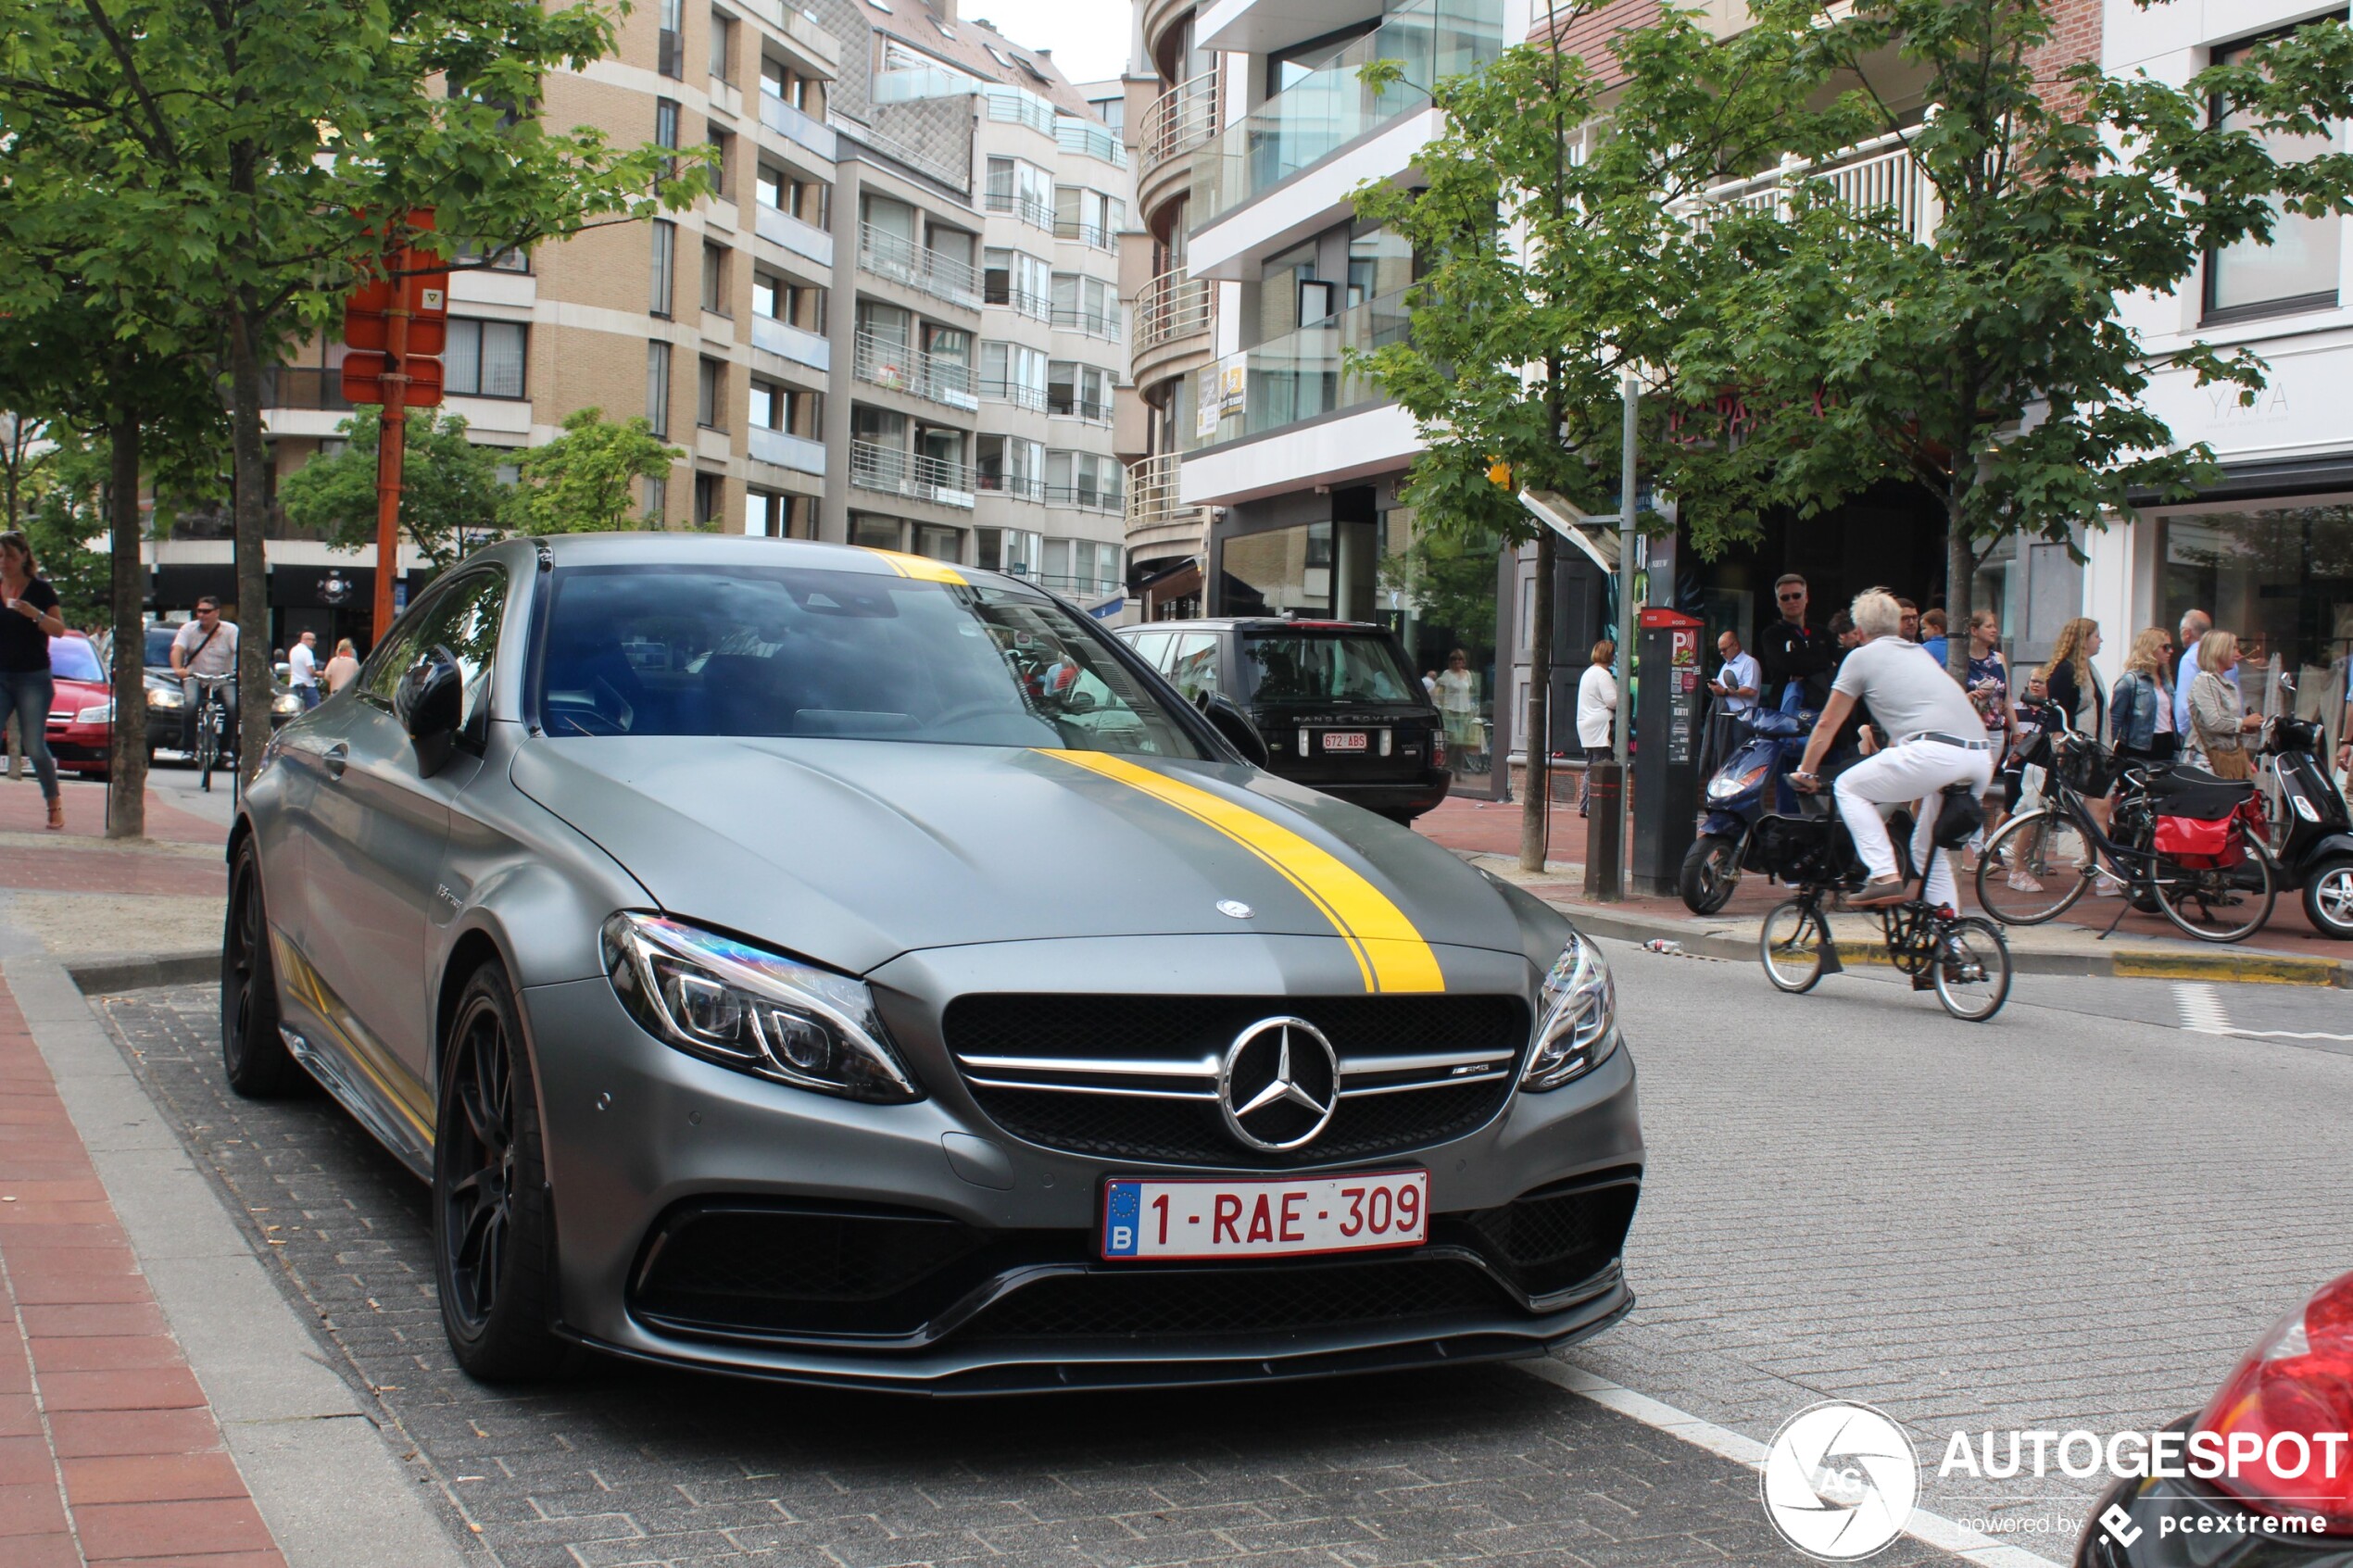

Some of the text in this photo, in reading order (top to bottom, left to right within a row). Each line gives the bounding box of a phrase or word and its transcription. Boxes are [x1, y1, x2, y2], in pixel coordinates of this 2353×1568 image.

[2208, 382, 2288, 419] YAYA
[1672, 632, 1687, 659] P
[1152, 1184, 1419, 1245] 1-RAE-309
[1113, 1225, 1132, 1249] B
